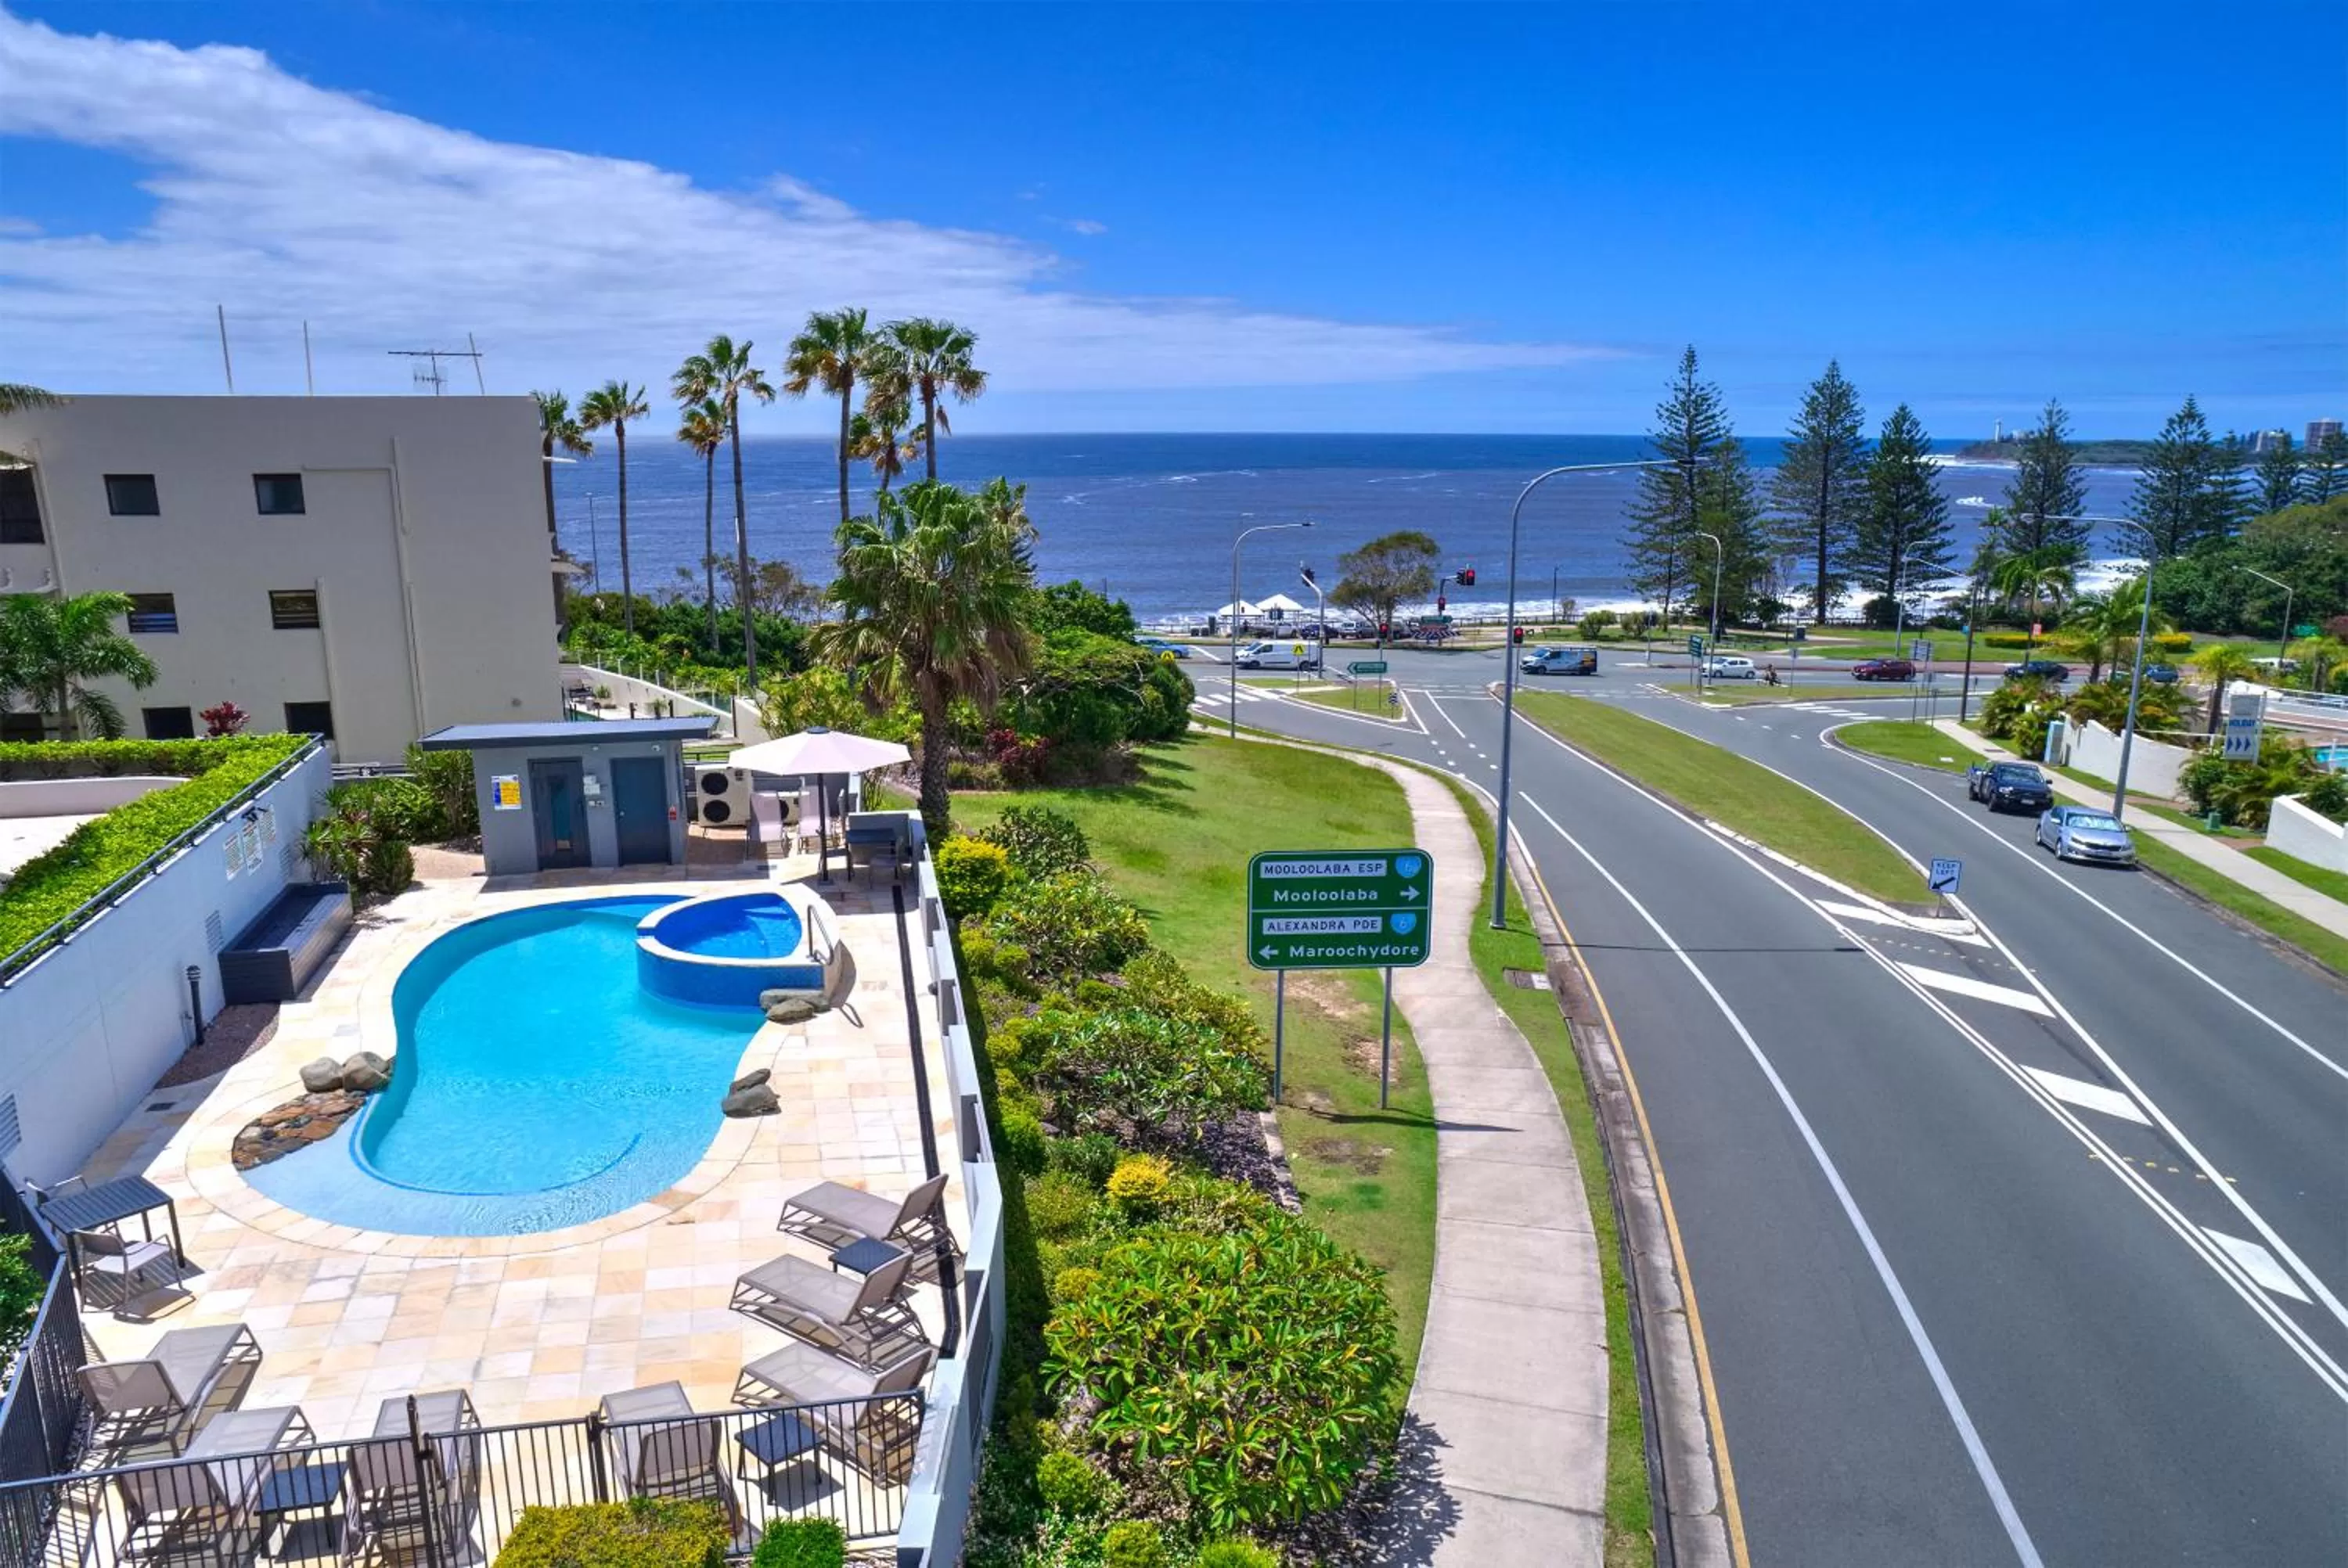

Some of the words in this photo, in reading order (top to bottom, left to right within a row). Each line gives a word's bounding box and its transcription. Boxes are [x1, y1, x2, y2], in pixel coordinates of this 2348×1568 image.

[1264, 863, 1351, 875] MOOLOOLABA
[1358, 862, 1383, 873] ESP
[1273, 889, 1378, 902] Mooloolaba
[1266, 920, 1346, 932] ALEXANDRA
[1353, 919, 1378, 930] PDE
[1289, 944, 1420, 958] Maroochydore
